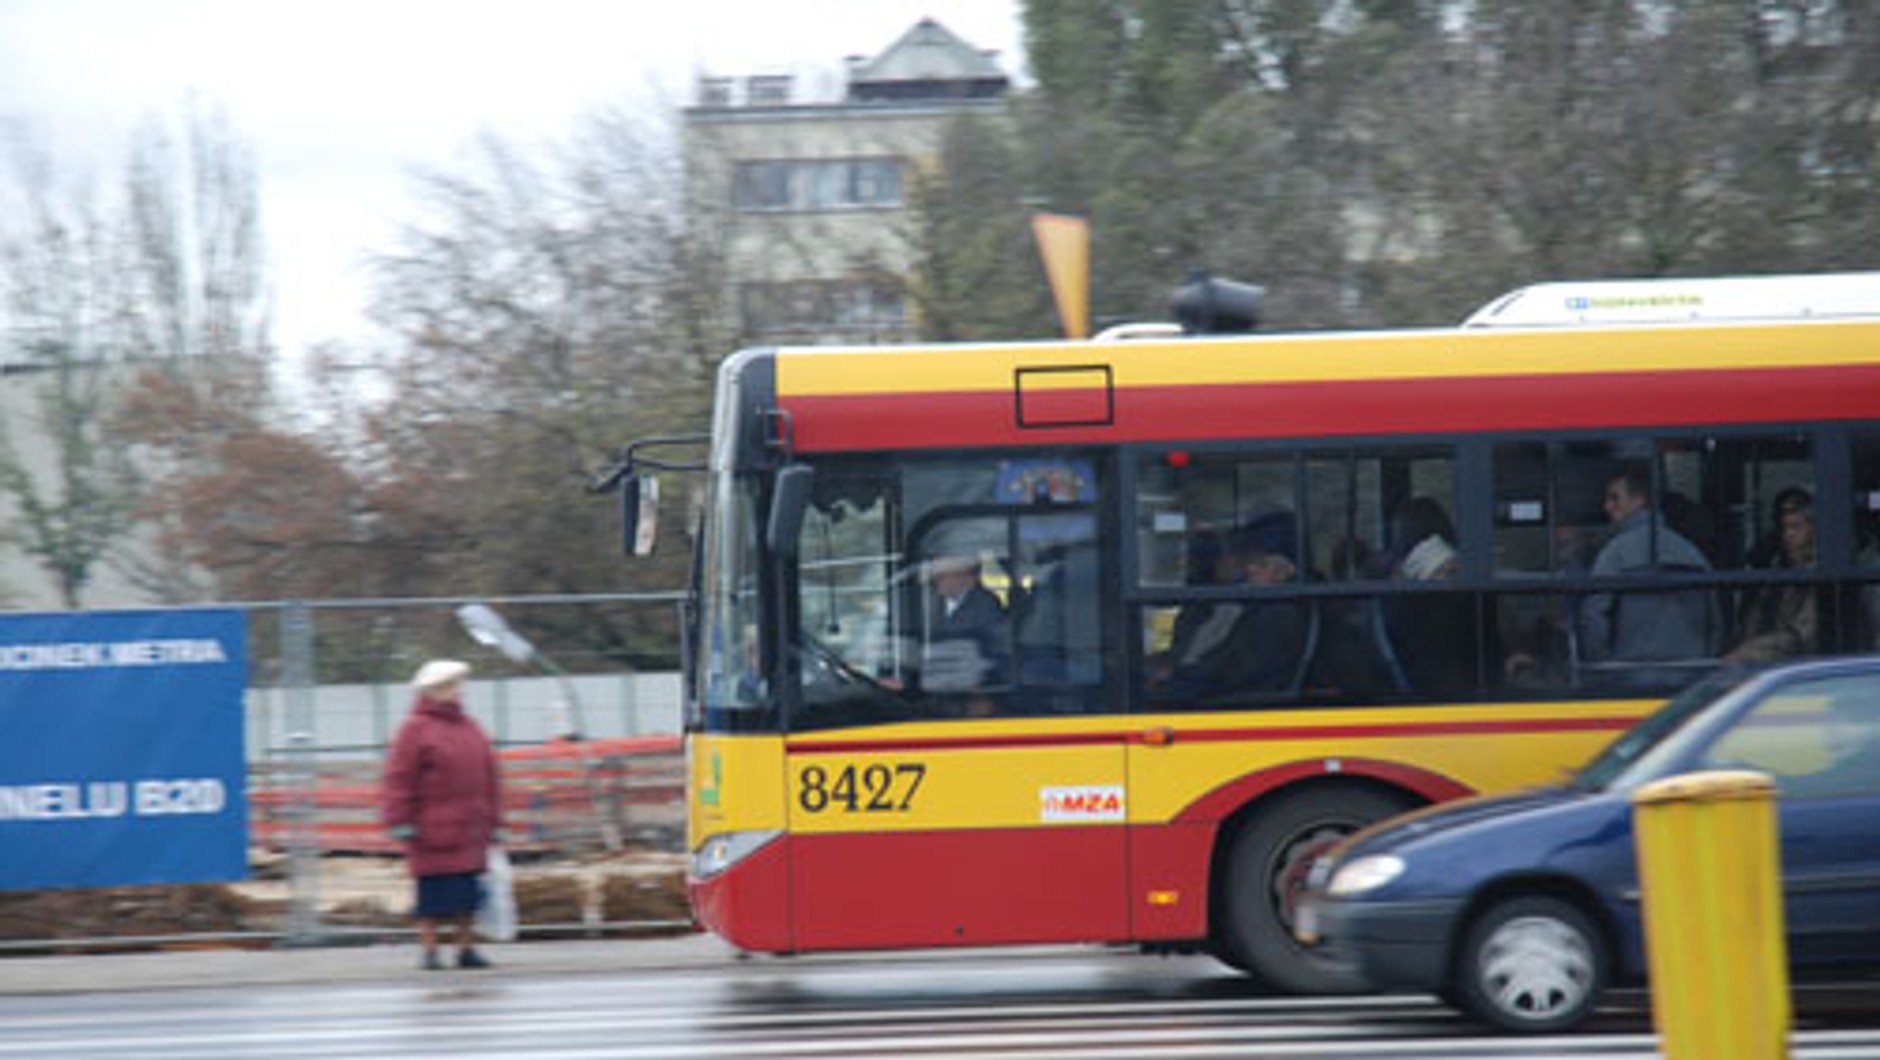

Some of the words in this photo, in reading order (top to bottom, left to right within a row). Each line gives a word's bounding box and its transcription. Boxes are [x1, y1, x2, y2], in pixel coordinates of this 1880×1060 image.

[108, 639, 226, 664] METRA
[134, 777, 226, 815] B20
[798, 762, 926, 812] 8427
[1061, 793, 1121, 813] MZA
